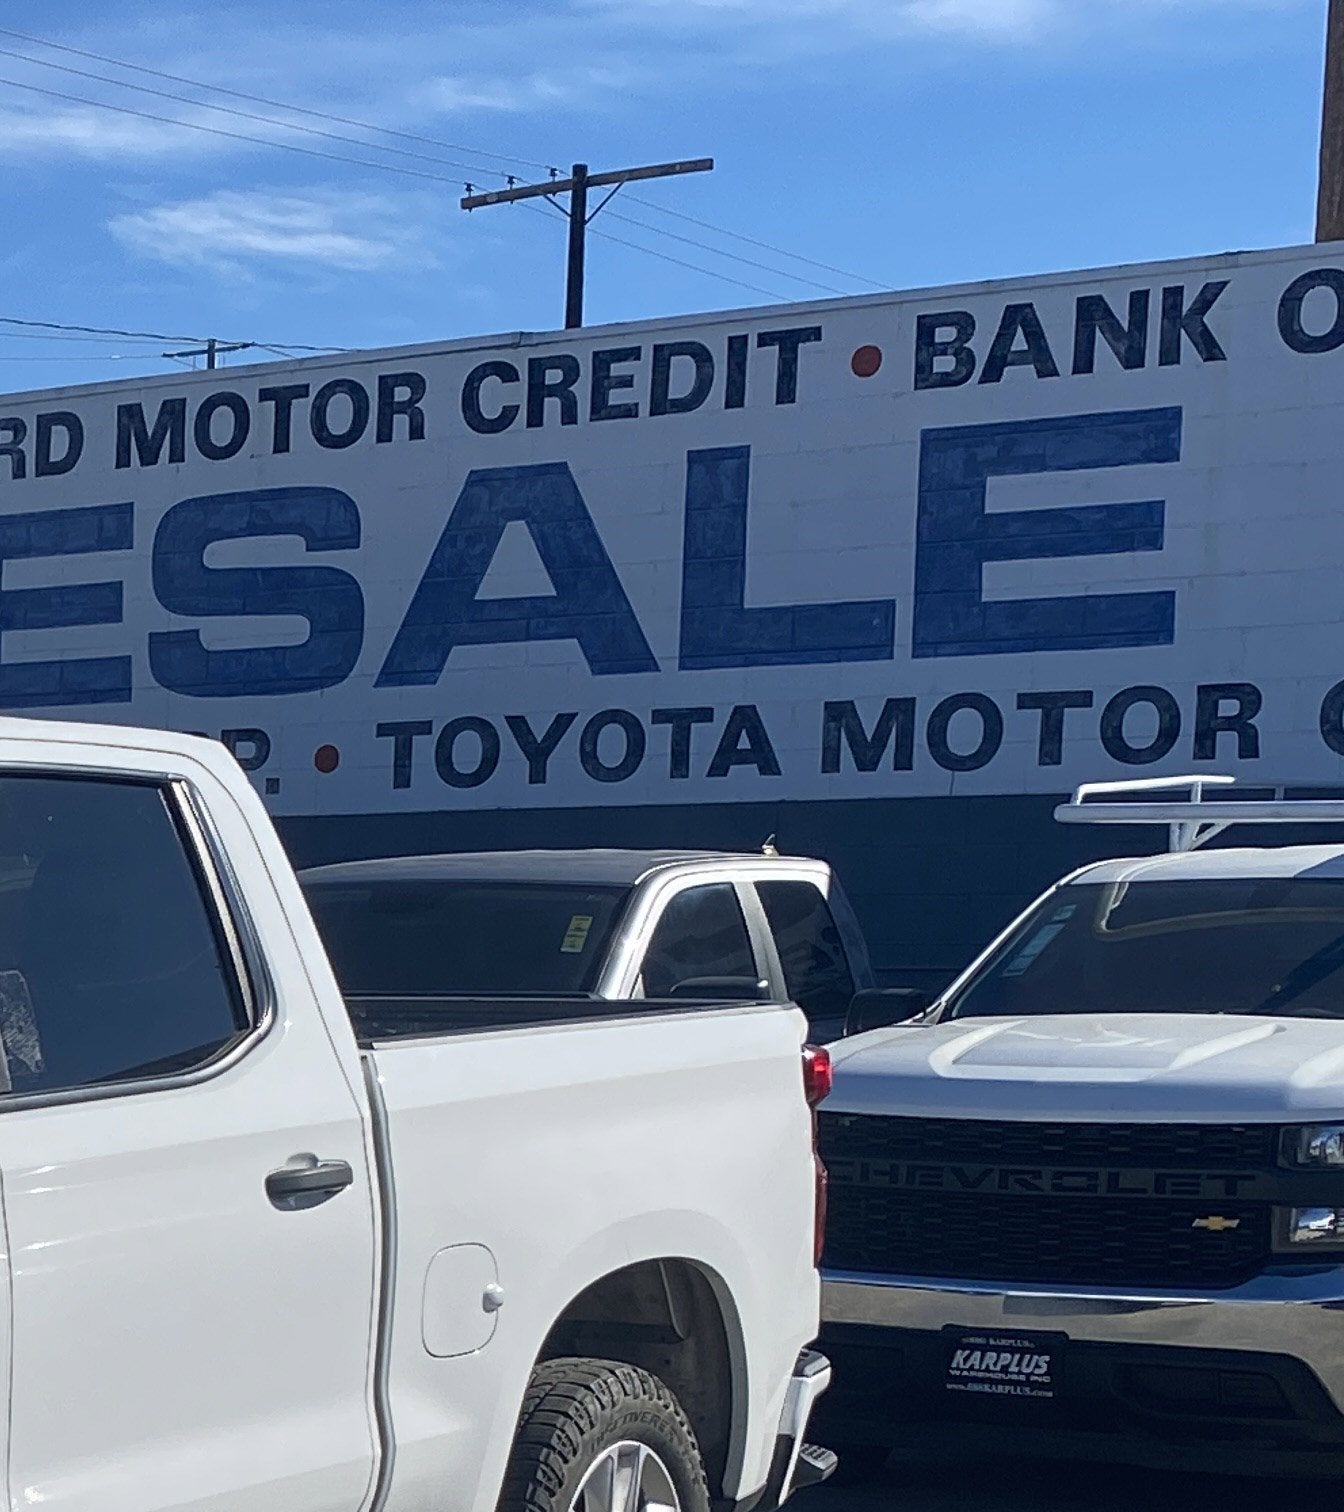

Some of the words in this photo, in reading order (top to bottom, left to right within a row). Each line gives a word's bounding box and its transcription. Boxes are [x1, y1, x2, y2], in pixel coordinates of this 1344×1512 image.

[114, 372, 427, 469] MOTOR
[461, 325, 823, 435] CREDIT
[914, 279, 1231, 391] BANK
[376, 705, 782, 789] TOYOTA
[821, 682, 1263, 773] MOTOR
[949, 1369, 1027, 1381] WAREHOUSE
[951, 1349, 1050, 1374] KARPLUS
